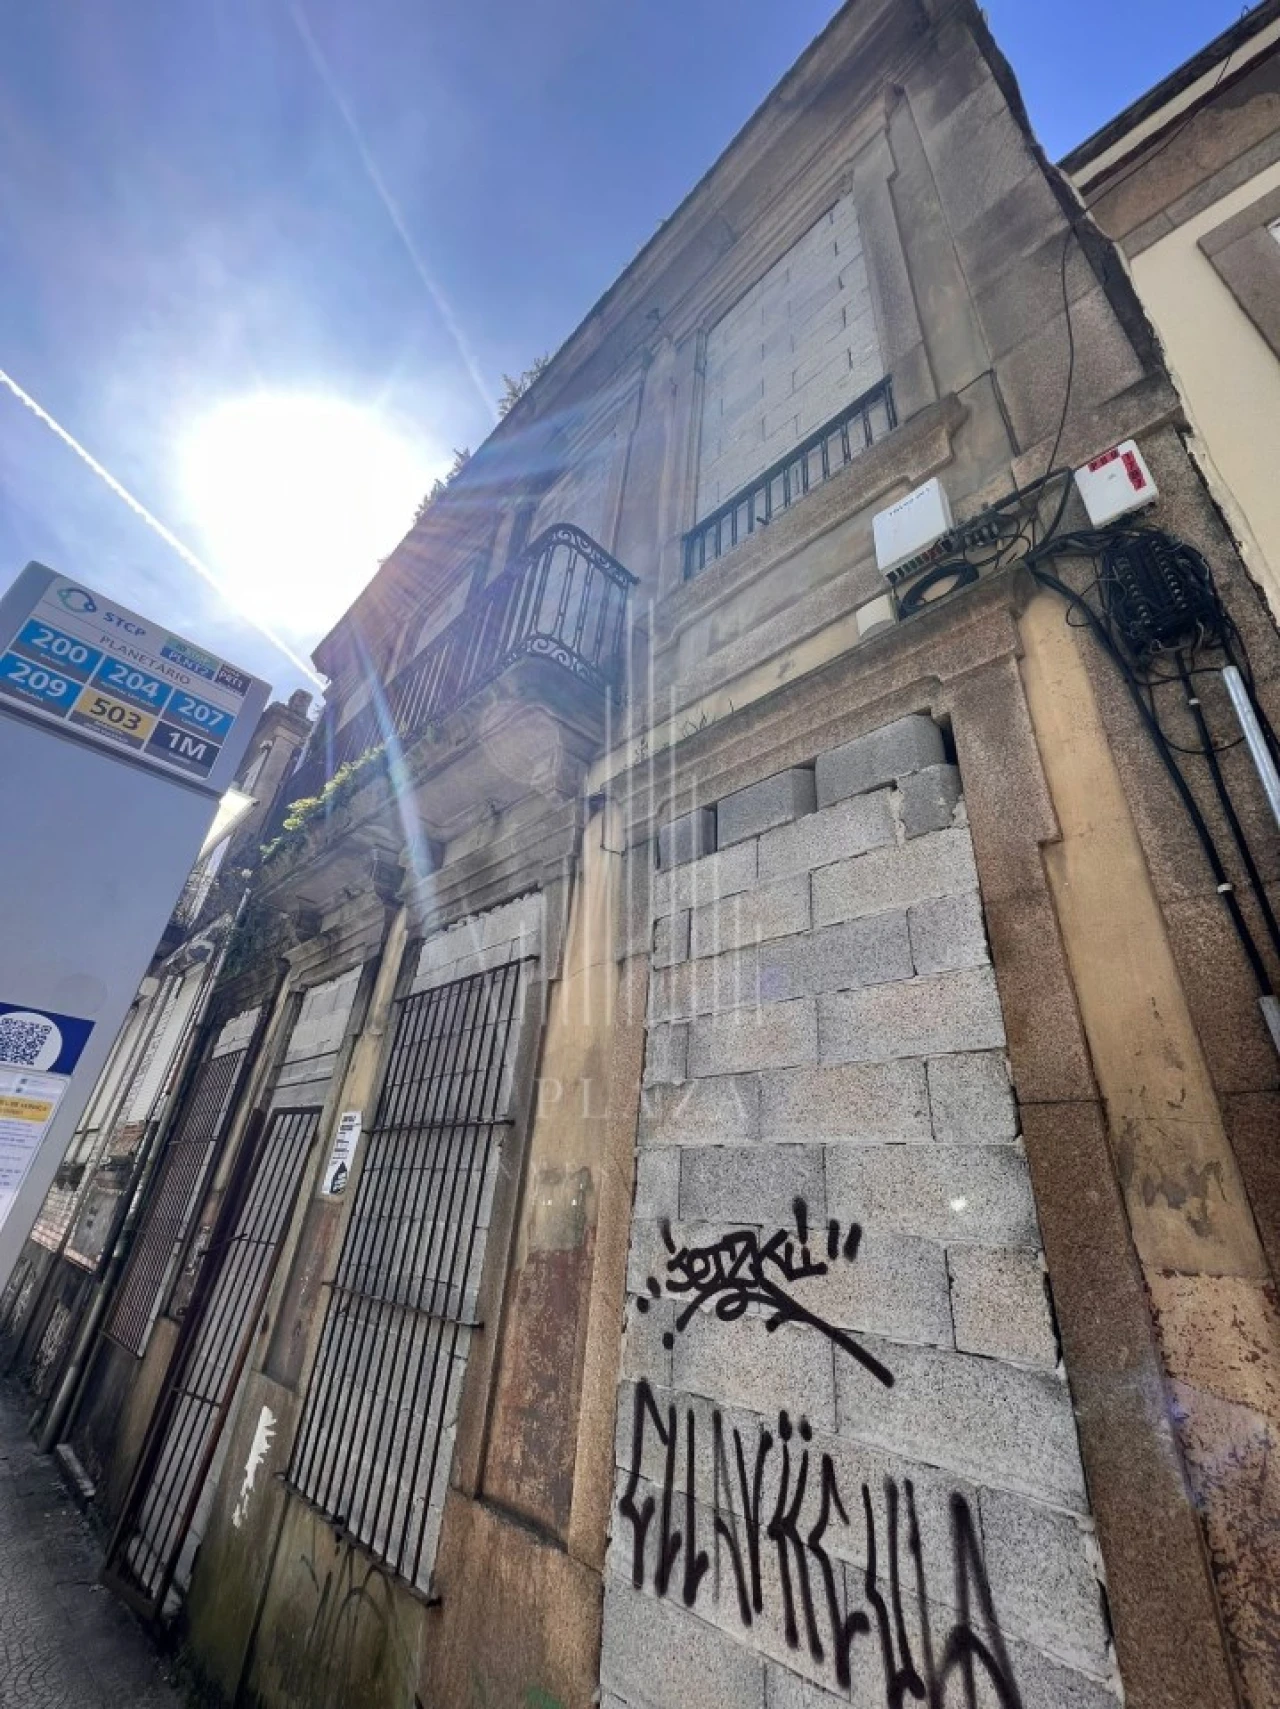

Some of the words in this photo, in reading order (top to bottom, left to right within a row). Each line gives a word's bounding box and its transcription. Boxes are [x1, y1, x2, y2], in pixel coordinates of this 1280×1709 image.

[103, 611, 146, 637] STCP
[32, 627, 88, 663] 200
[7, 662, 68, 698] 209
[108, 665, 158, 697] 204
[89, 697, 142, 731] 503
[178, 697, 224, 728] 207
[168, 732, 206, 761] 1M
